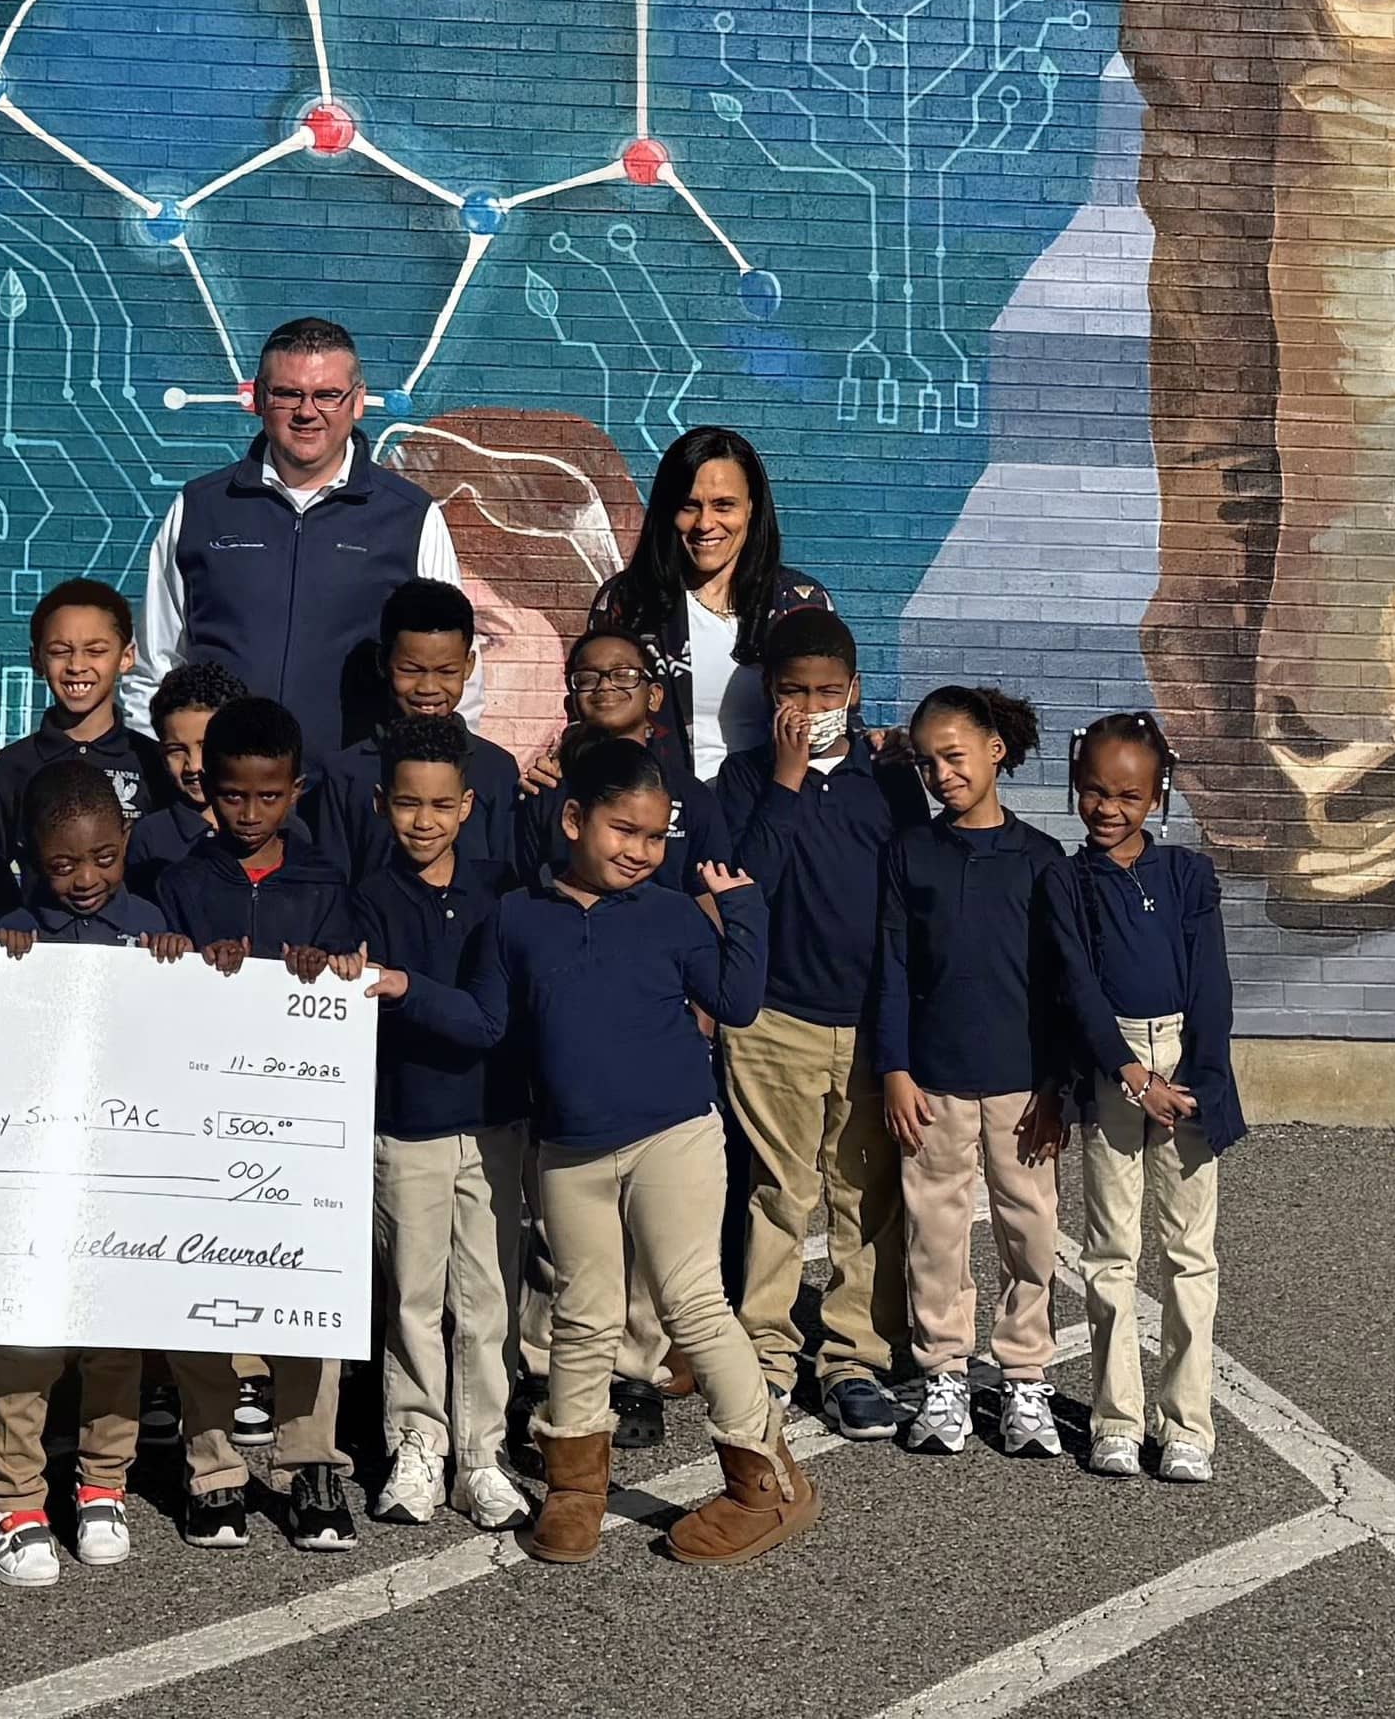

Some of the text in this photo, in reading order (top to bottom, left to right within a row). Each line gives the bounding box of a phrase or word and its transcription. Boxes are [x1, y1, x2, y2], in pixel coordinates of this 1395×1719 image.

[287, 993, 347, 1021] 2025
[189, 1060, 210, 1072] Date
[100, 1098, 161, 1128] PAC
[176, 1232, 305, 1270] Chevrolet
[273, 1307, 343, 1329] CARES
